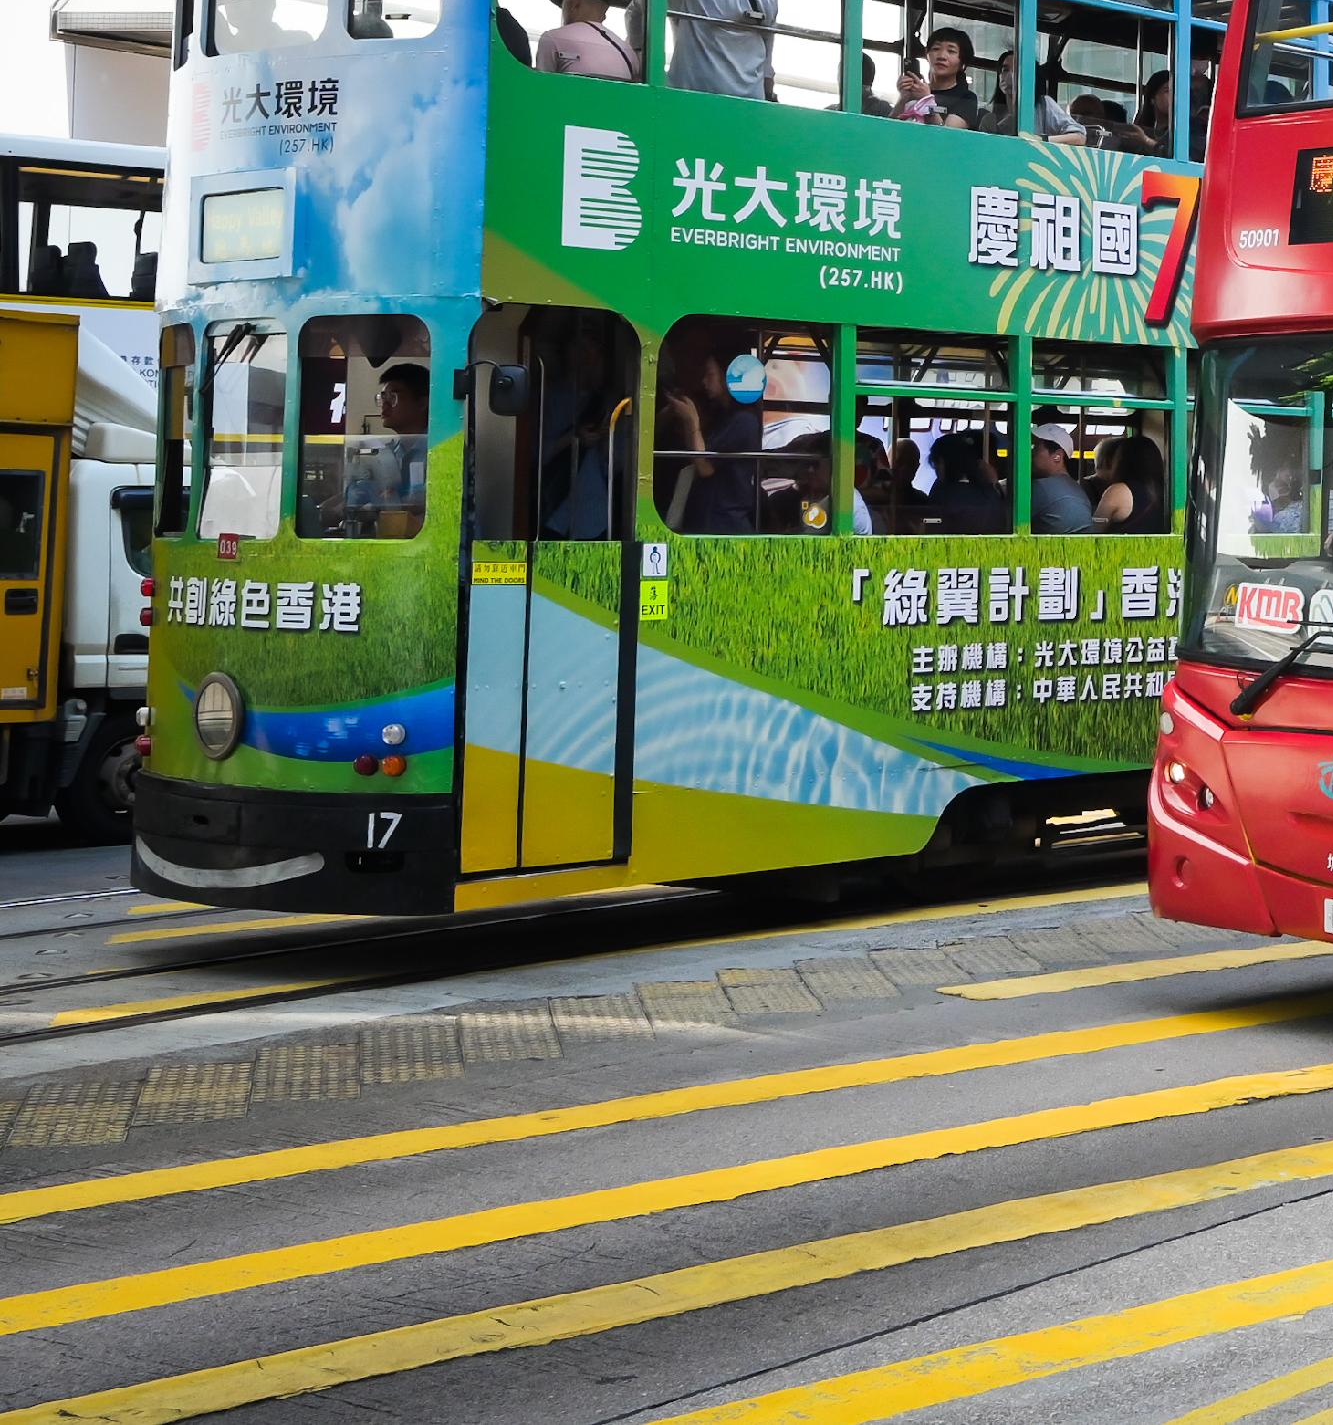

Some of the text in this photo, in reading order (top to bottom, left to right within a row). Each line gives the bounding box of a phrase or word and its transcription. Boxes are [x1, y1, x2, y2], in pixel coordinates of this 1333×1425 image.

[221, 77, 340, 124] 光大環境
[268, 121, 337, 136] ENVIRONMENT
[279, 137, 335, 156] (257.HK)
[671, 157, 902, 239] 光大環境
[671, 226, 902, 263] EVERBRIGHT ENVIRONMENT
[968, 186, 1138, 277] 慶祖國
[1239, 228, 1281, 250] 50901
[818, 264, 904, 294] (257.HK)
[219, 538, 238, 557] 039
[168, 575, 361, 632] 共創綠色香港
[641, 604, 666, 616] EXIT
[365, 812, 403, 849] 17
